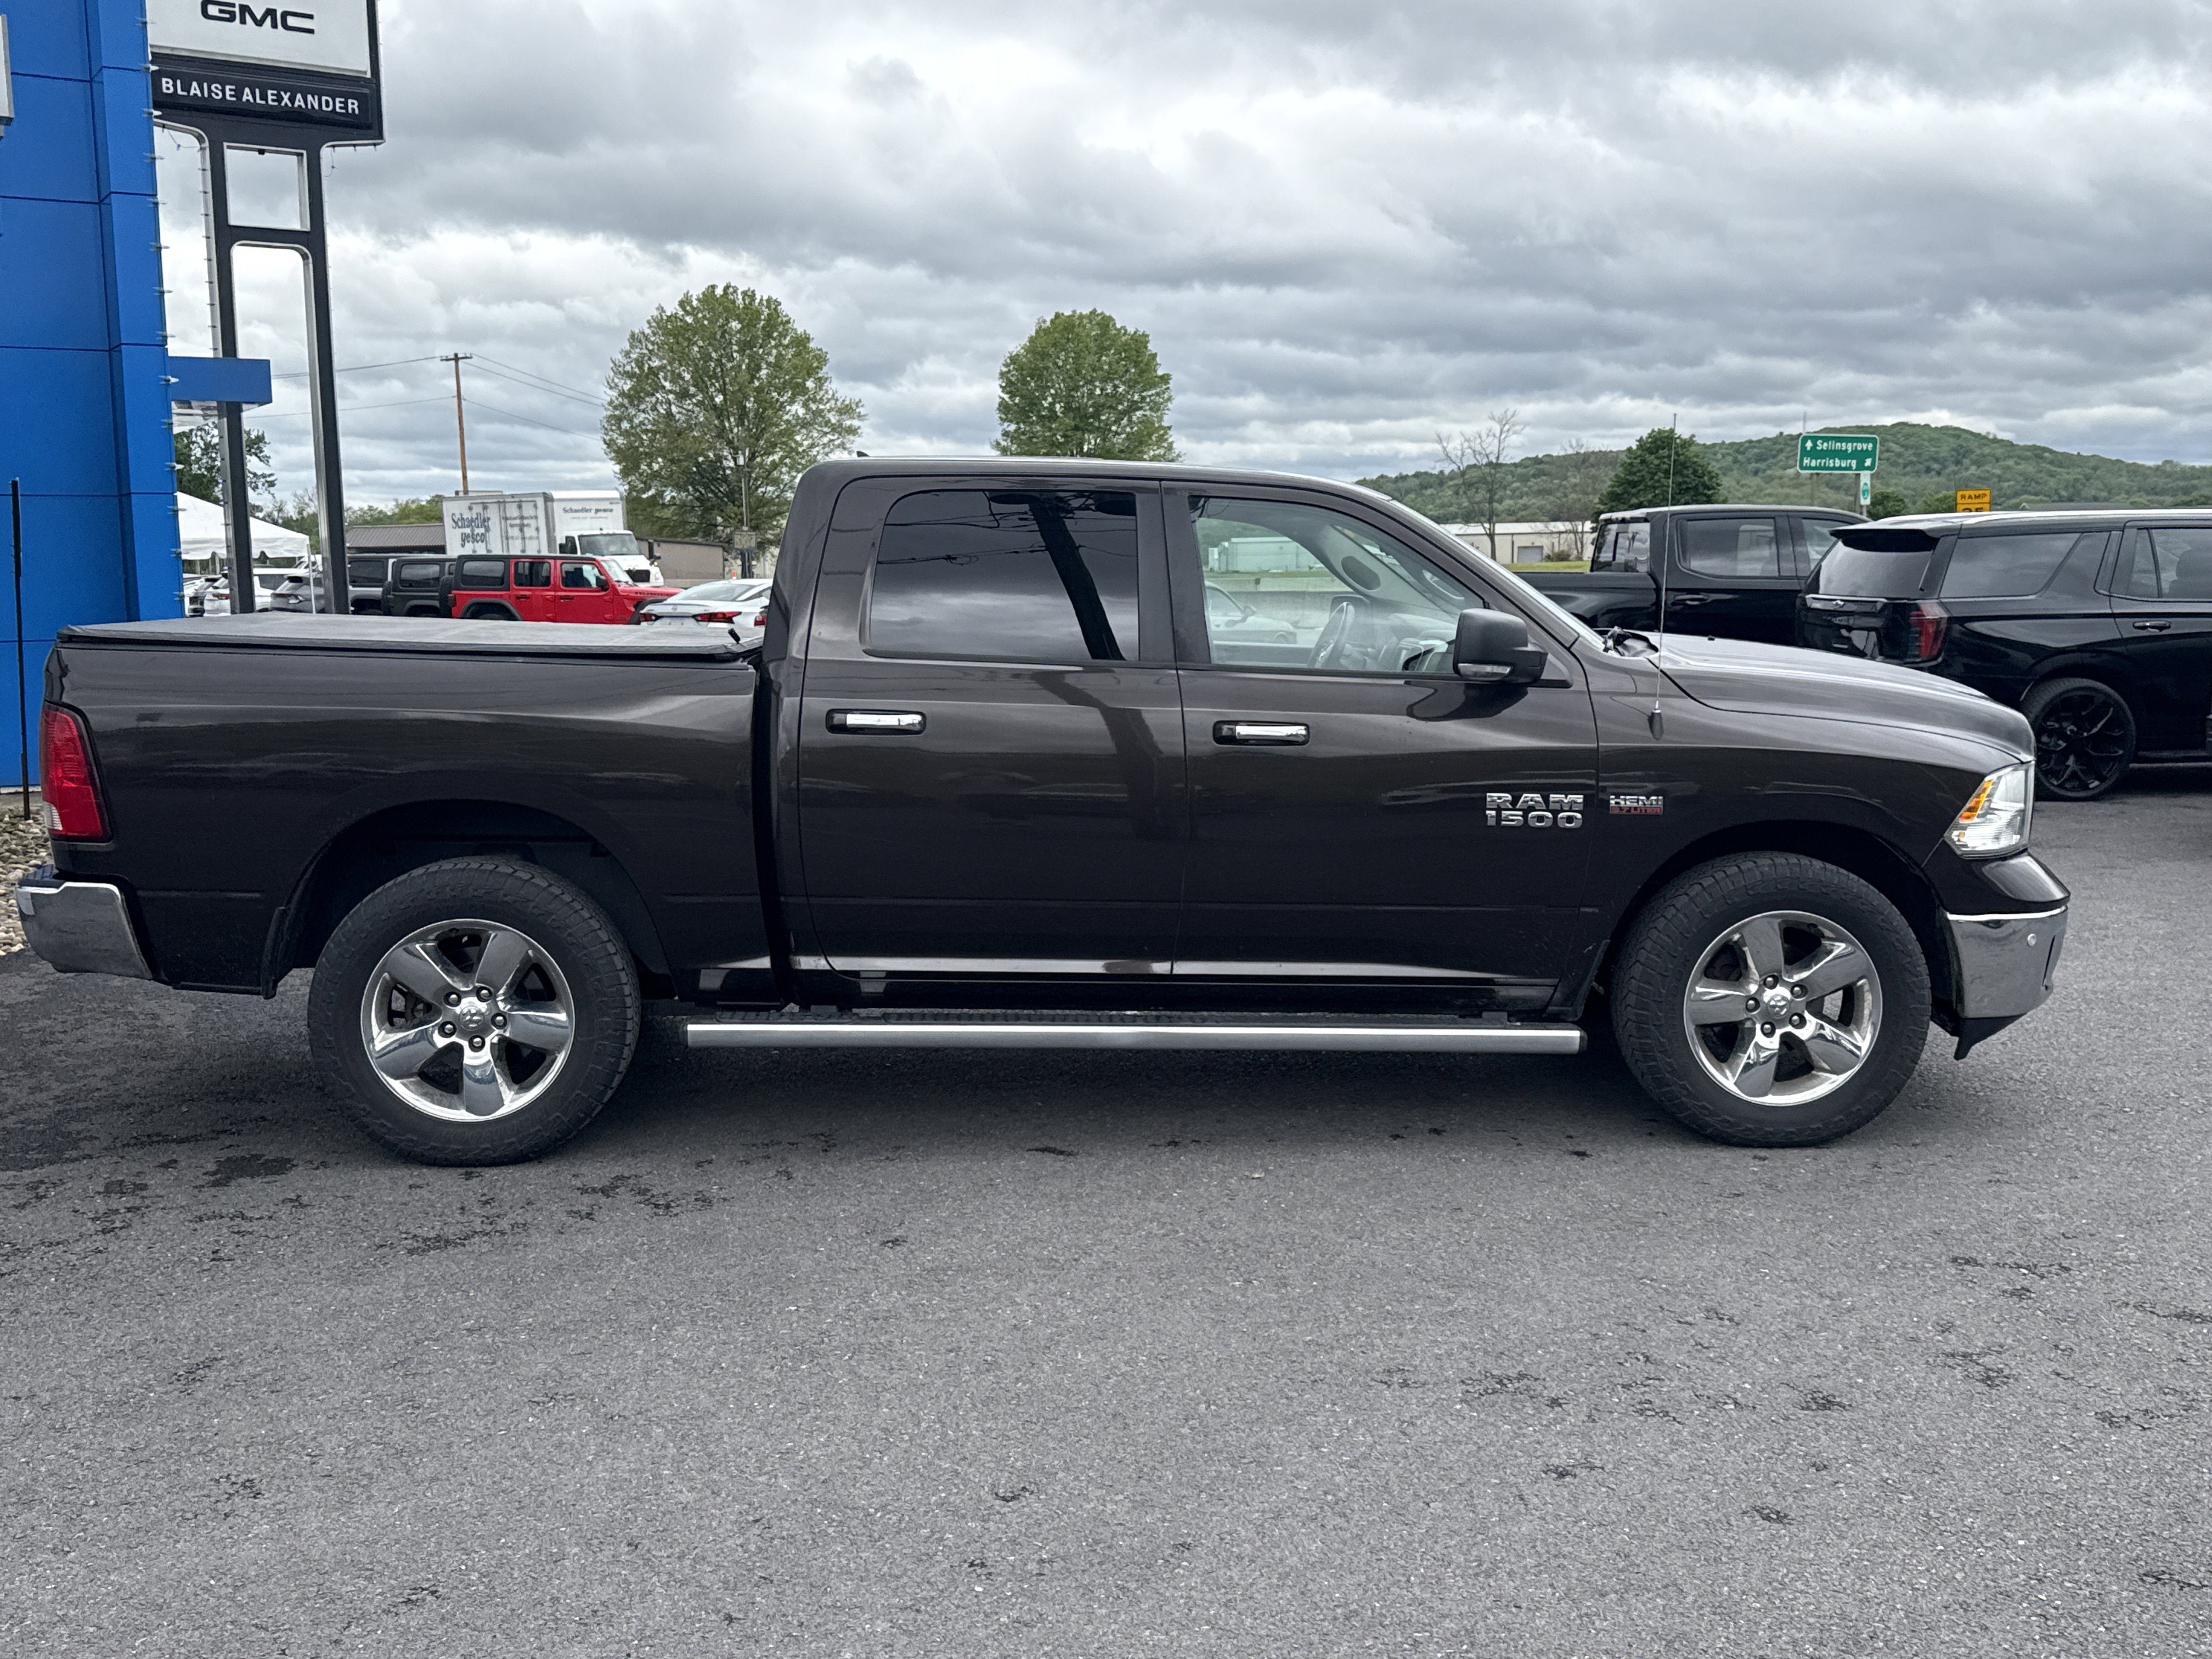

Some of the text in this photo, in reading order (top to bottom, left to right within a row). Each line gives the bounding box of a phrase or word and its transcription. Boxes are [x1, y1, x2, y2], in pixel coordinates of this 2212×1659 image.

[201, 0, 315, 35] GMC
[161, 77, 359, 115] BLAISE ALEXANDER
[1816, 439, 1873, 453] Selinsgrove
[1803, 457, 1857, 470] Harrisburg
[451, 512, 491, 529] Schaedler
[461, 532, 486, 548] yesco
[1486, 792, 1584, 810] RAM
[1610, 795, 1663, 806] HEMI
[1485, 810, 1583, 828] 1500
